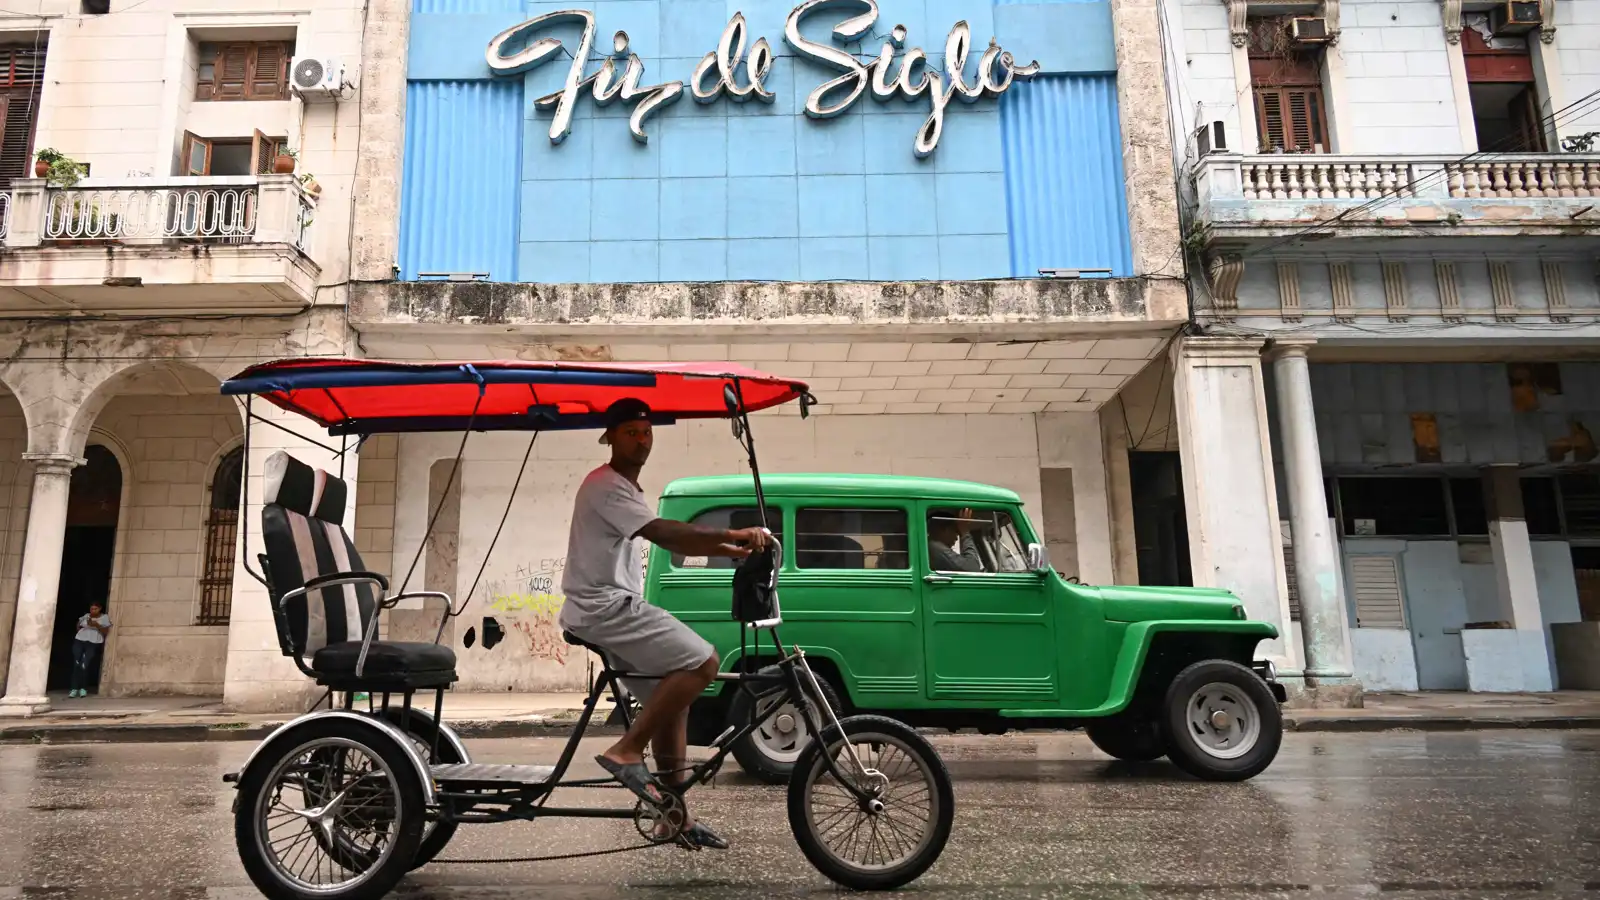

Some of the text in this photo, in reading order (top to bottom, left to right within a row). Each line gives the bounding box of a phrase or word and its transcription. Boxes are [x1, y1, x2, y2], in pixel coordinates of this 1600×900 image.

[485, 0, 1041, 159] Fin de Siglo
